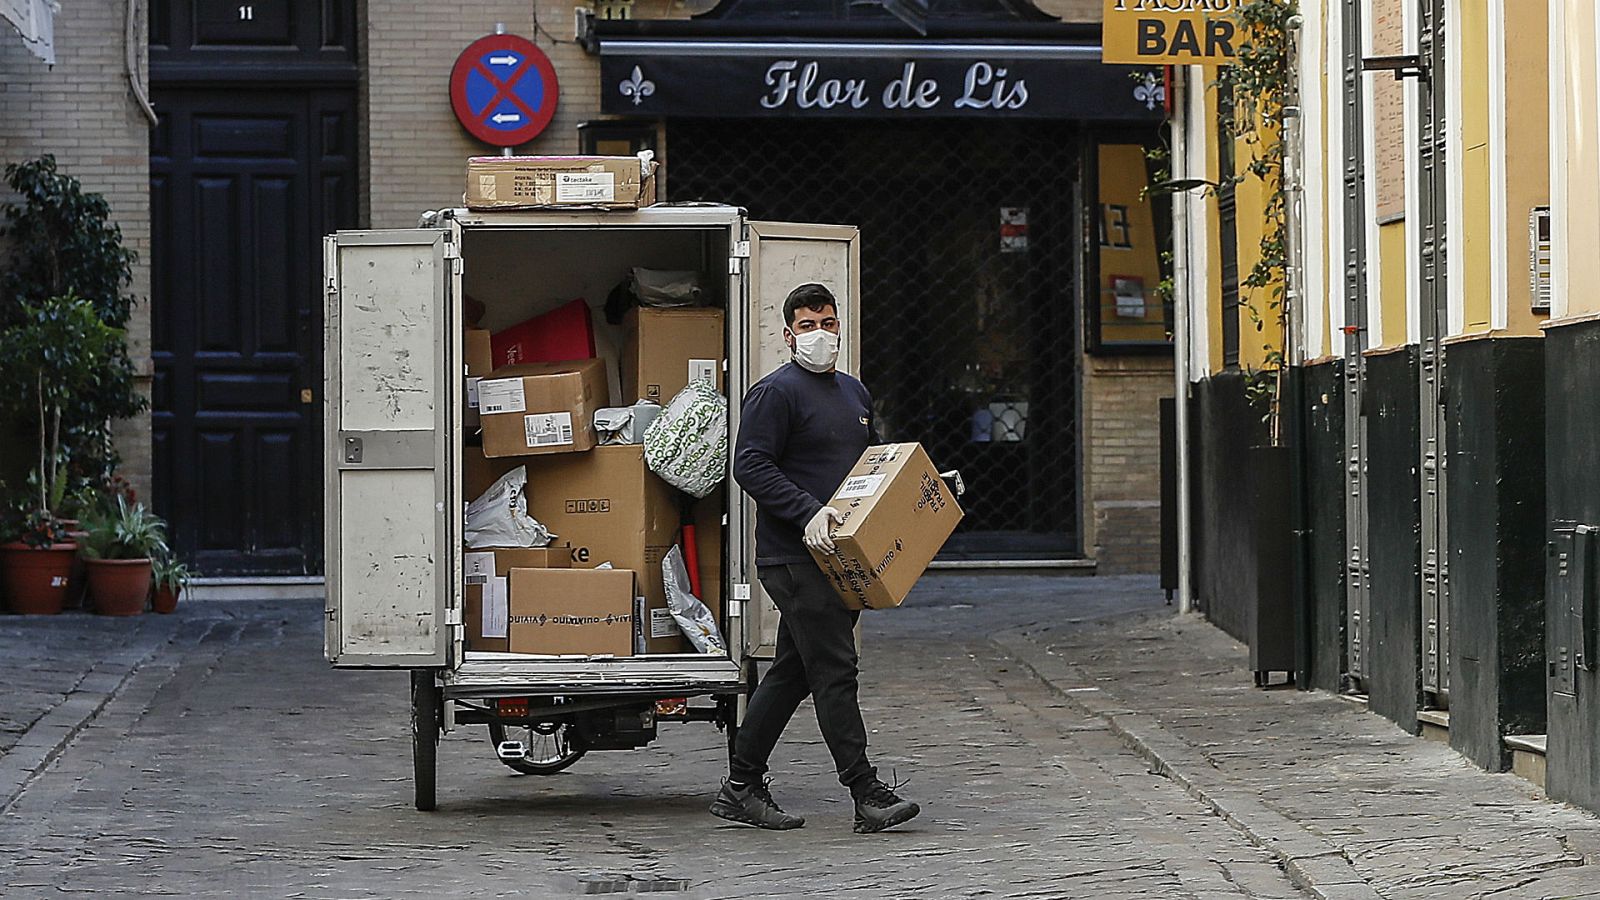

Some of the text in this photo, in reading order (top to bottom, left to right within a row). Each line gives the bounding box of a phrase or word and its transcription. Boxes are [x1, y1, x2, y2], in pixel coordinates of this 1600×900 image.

[239, 6, 252, 20] 11
[1137, 19, 1236, 57] BAR
[759, 60, 1029, 109] Flor de Lis
[674, 441, 711, 476] GROUPON
[703, 436, 725, 477] GROUPON
